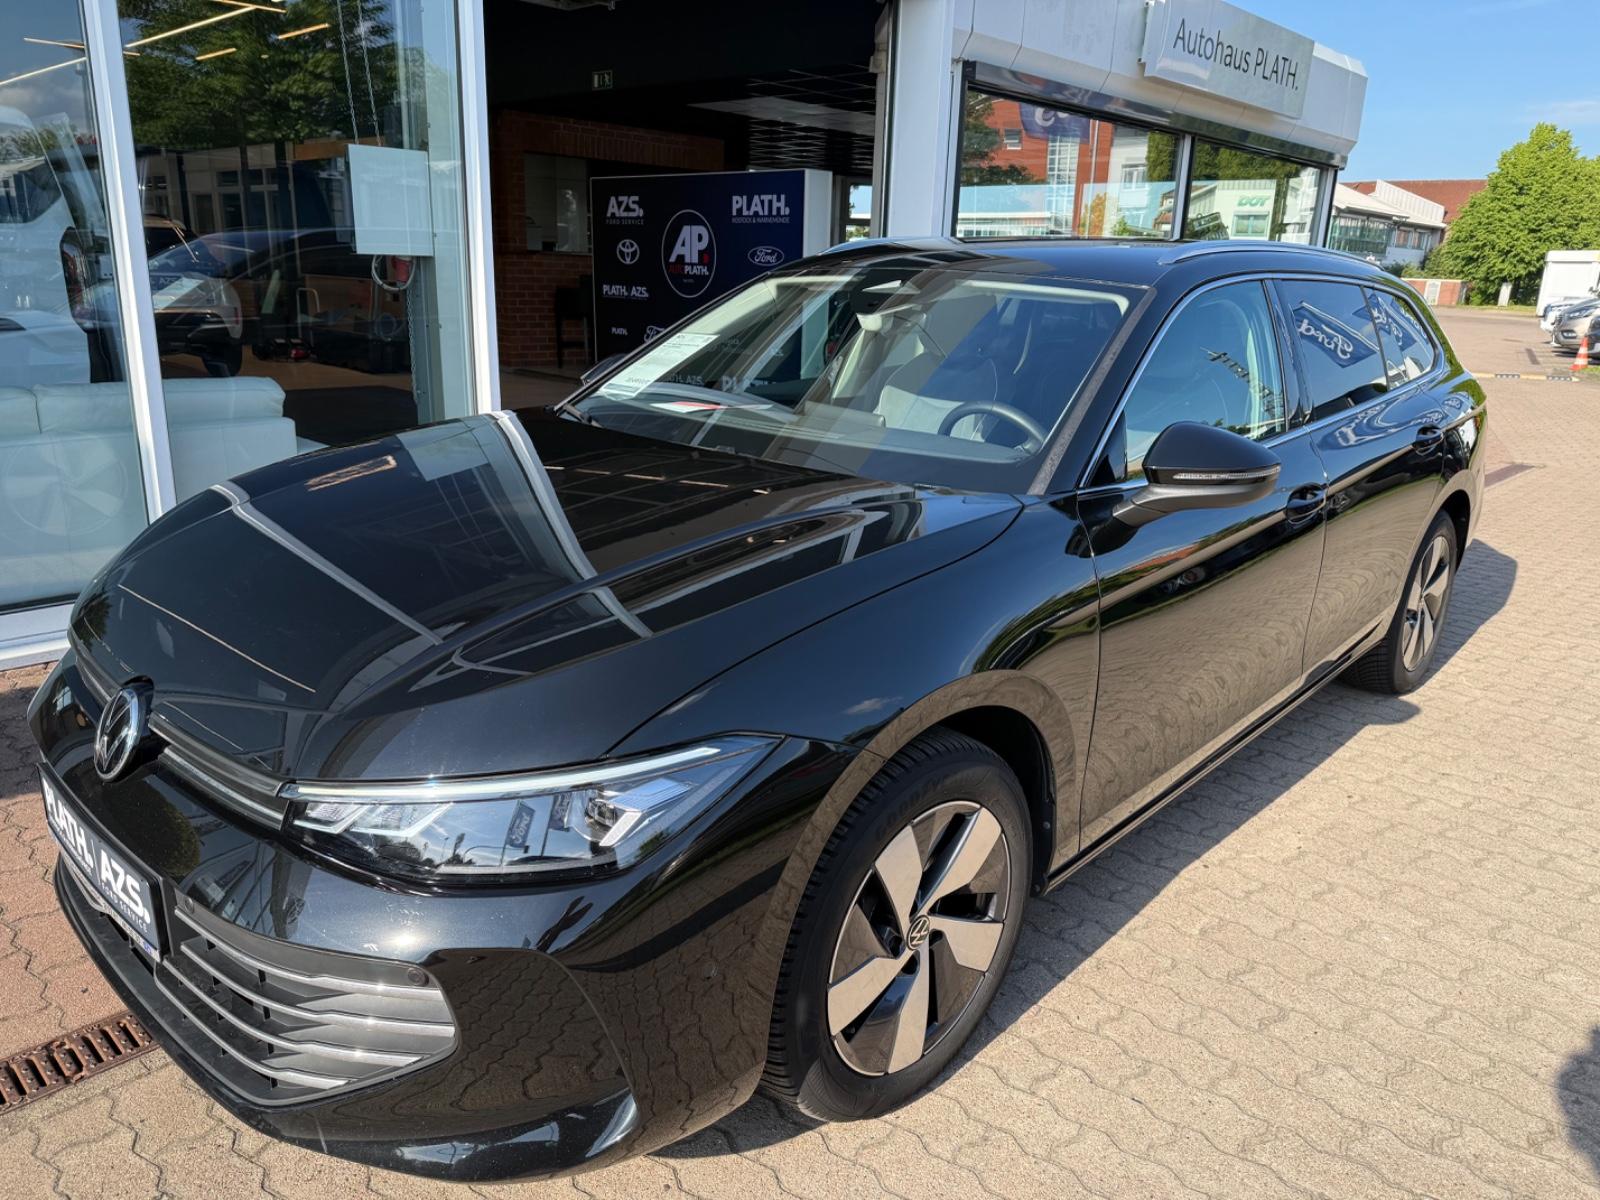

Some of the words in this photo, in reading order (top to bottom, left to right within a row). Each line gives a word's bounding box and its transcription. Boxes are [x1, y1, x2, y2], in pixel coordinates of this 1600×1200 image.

[1173, 18, 1251, 73] Autohaus
[1253, 47, 1299, 91] PLATH.
[607, 196, 644, 217] AZS.
[732, 194, 790, 216] PLATH.
[754, 249, 778, 263] Ford
[602, 284, 628, 296] PLATH.
[630, 285, 649, 298] AZS.
[42, 776, 95, 870] PLATH.
[100, 848, 151, 925] AZS.
